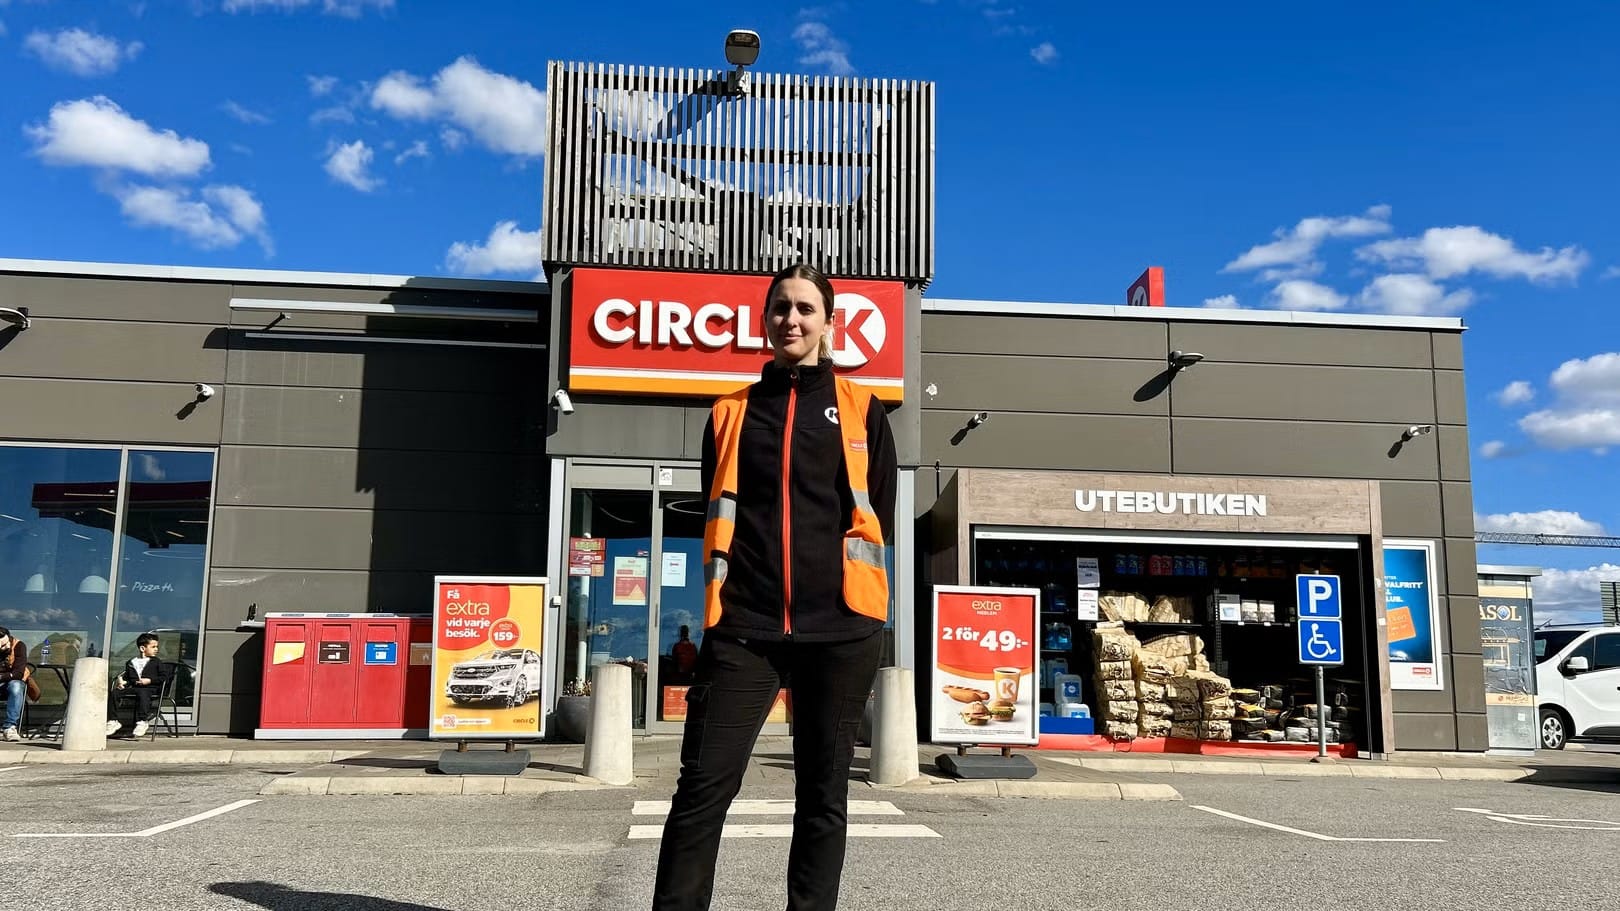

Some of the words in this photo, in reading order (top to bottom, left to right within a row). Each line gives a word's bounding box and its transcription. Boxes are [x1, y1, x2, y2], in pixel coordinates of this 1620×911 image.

[593, 297, 775, 349] CIRCL
[1074, 489, 1267, 517] UTEBUTIKEN
[446, 589, 460, 599] Få
[1308, 579, 1333, 614] P
[446, 600, 490, 616] extra
[972, 600, 1002, 611] extra
[446, 618, 462, 627] vid
[463, 618, 491, 629] varje
[446, 628, 480, 638] besök.
[942, 627, 953, 640] 2
[955, 626, 980, 641] för
[979, 630, 1029, 652] 49:-
